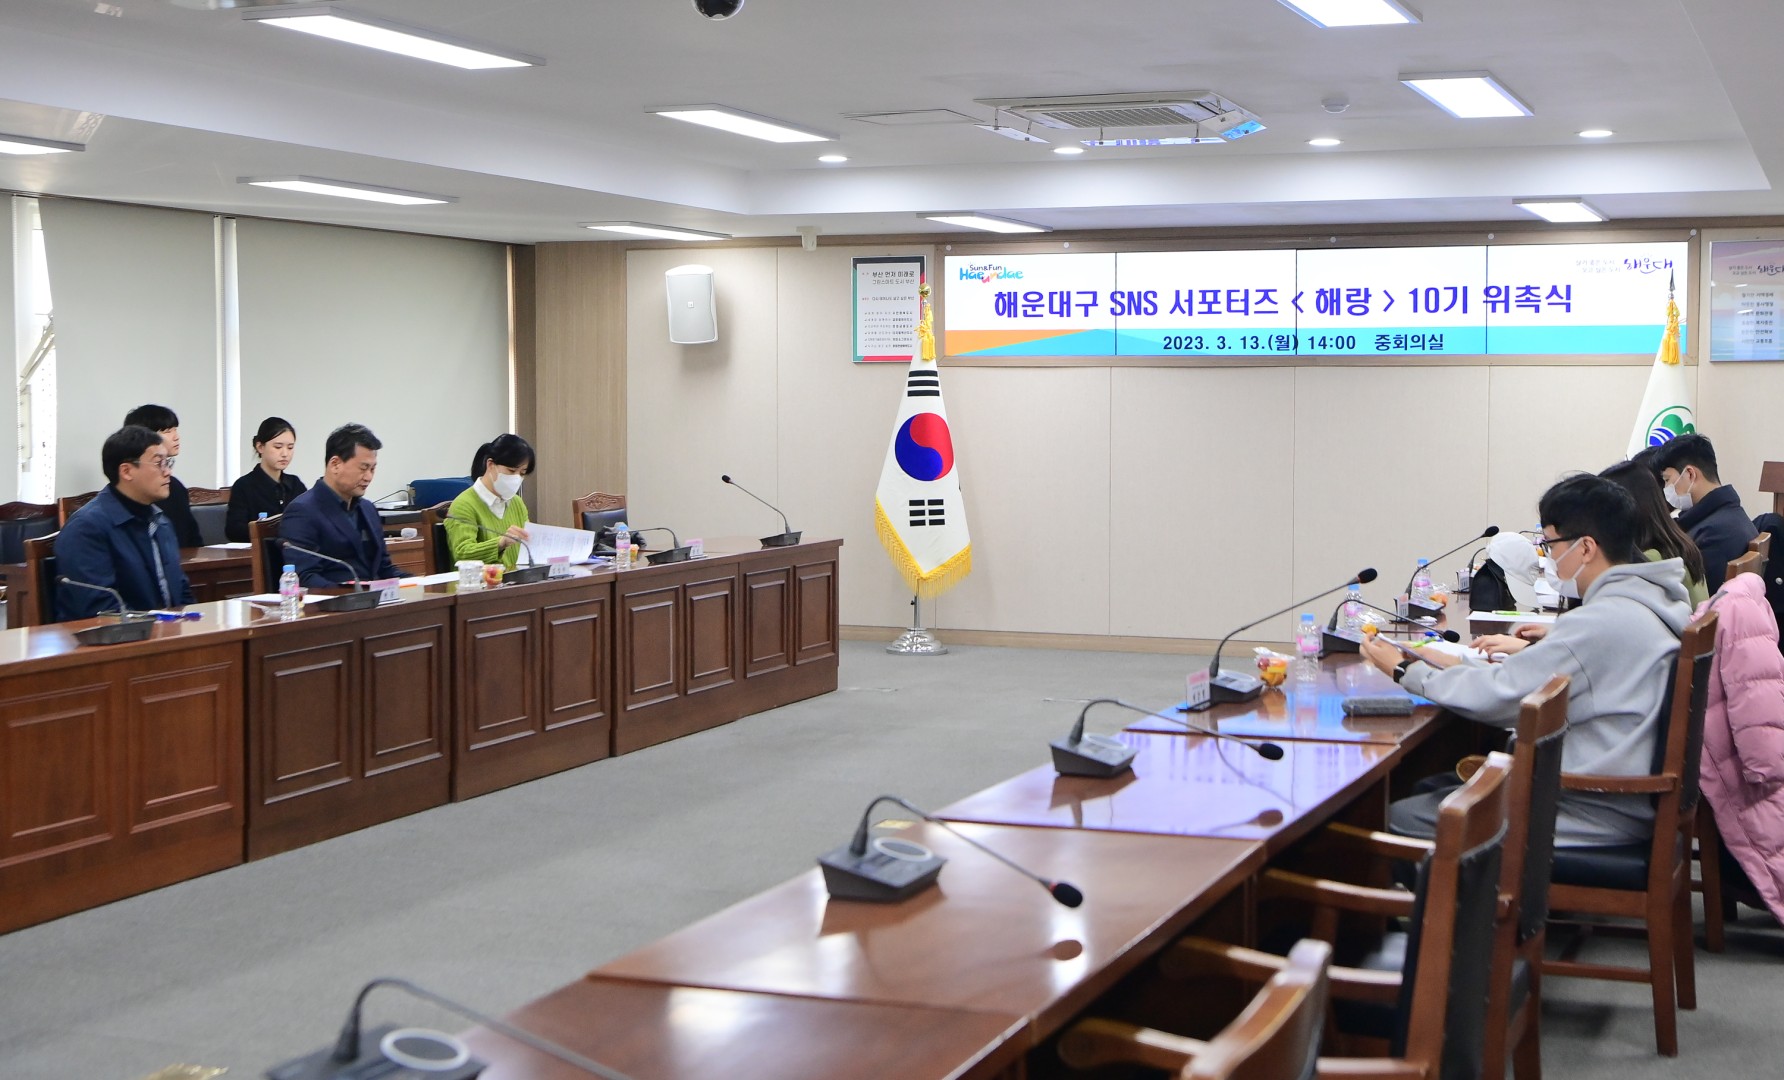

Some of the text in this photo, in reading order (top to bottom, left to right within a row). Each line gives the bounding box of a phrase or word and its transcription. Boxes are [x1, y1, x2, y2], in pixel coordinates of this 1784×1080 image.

[959, 267, 1024, 283] Haeundae
[994, 290, 1099, 318] 해운대구
[1109, 289, 1158, 317] SNS
[1169, 288, 1279, 317] 서포터즈
[1315, 287, 1372, 317] 해랑
[1408, 286, 1468, 314] 10기
[1482, 284, 1572, 314] 위촉식
[1163, 335, 1209, 350] 2023.
[1216, 335, 1233, 350] 3.
[1307, 335, 1356, 350] 14:00
[1374, 333, 1444, 352] 중회의실
